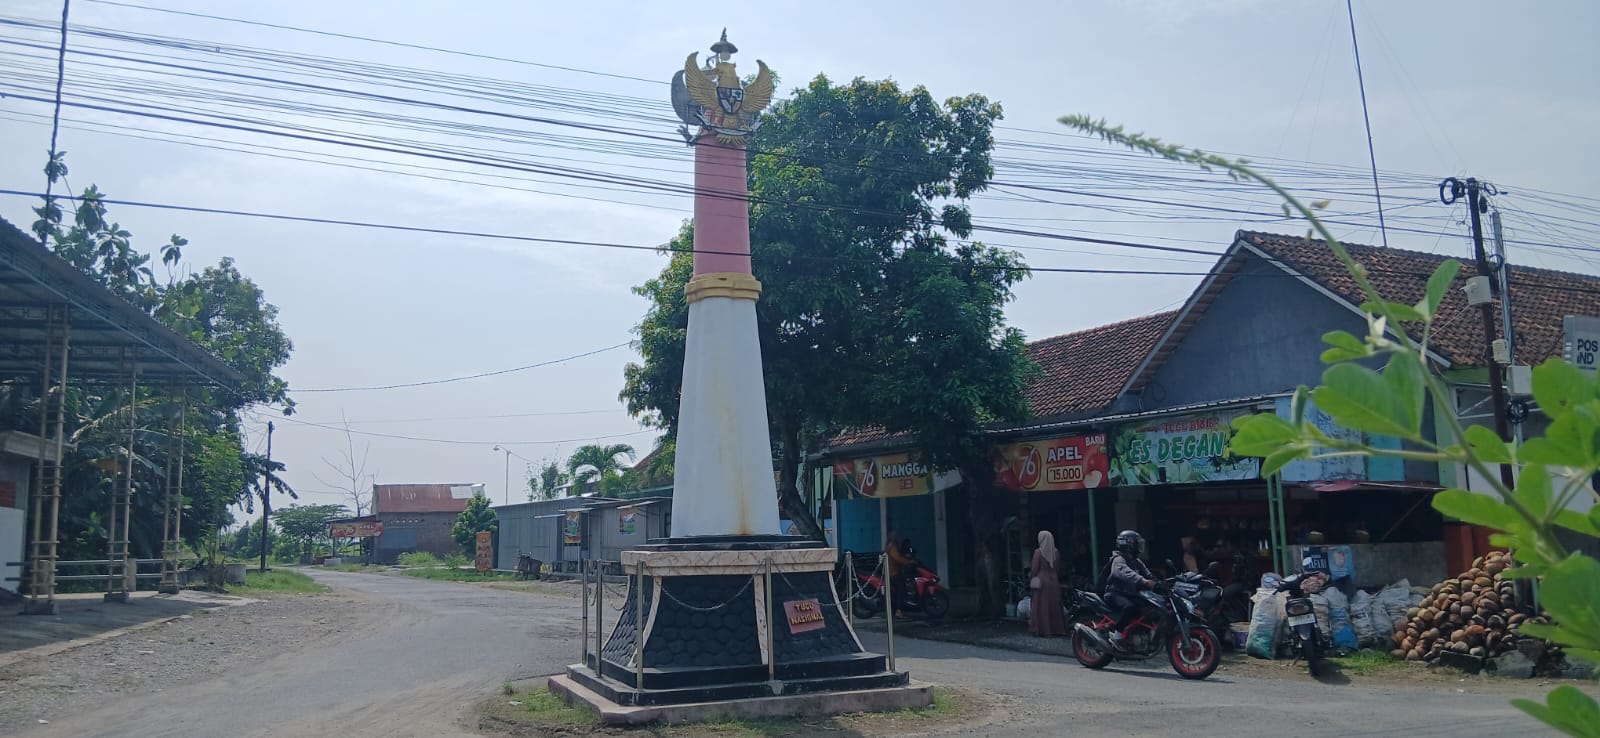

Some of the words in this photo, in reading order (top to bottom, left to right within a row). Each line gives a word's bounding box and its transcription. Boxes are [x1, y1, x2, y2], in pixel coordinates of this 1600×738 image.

[1577, 338, 1598, 352] POS
[1085, 436, 1105, 447] BARU
[1129, 438, 1152, 463] ES
[1156, 430, 1225, 462] DEGAN
[1047, 446, 1082, 463] APEL
[882, 462, 928, 479] MANGGA
[1018, 447, 1036, 484] 76
[859, 460, 875, 494] 76
[1053, 467, 1081, 481] 15.000
[795, 601, 814, 611] TUGU
[790, 614, 825, 624] NASIONAL
